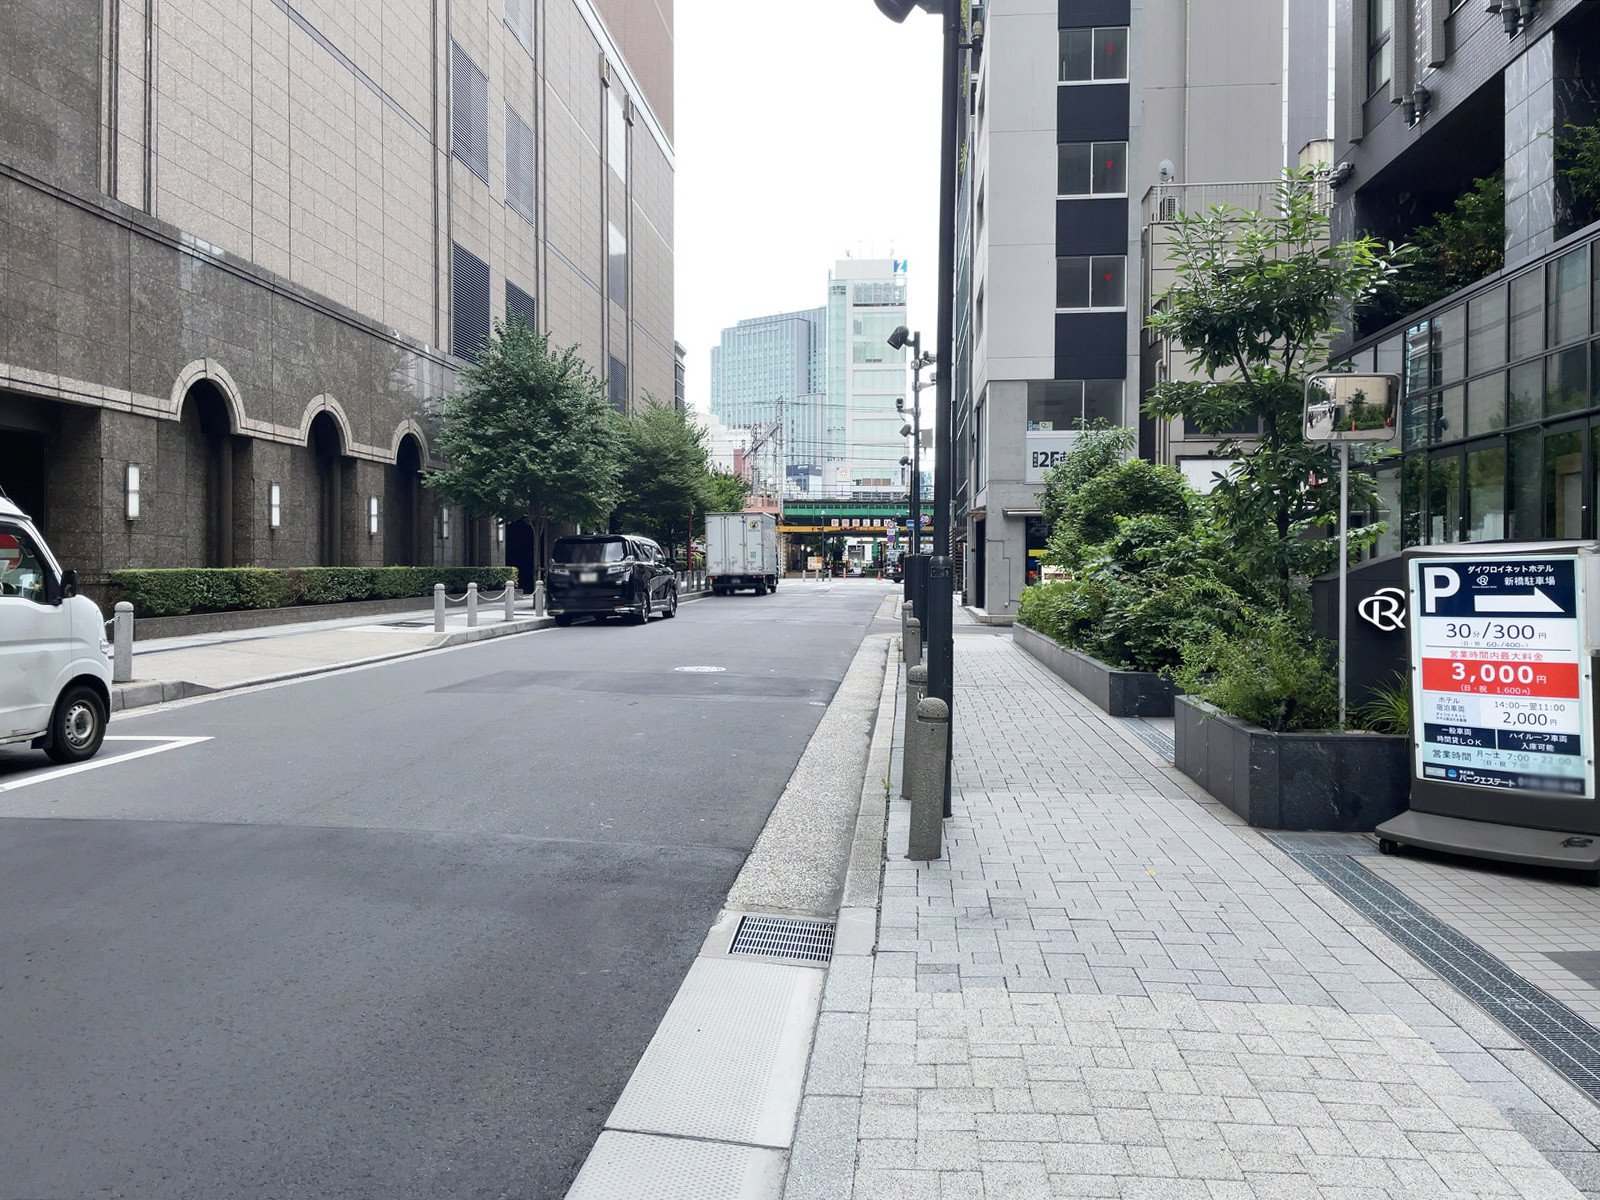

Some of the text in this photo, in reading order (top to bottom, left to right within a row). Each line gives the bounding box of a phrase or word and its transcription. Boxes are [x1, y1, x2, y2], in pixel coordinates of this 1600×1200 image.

[1467, 565, 1554, 574] ダイワロイネットホテル
[1504, 576, 1556, 586] 新橋駐車場
[1424, 567, 1460, 613] P
[1449, 650, 1544, 661] 営業時間内最大料金
[1452, 662, 1547, 684] 3,000円
[1438, 696, 1460, 704] ホテル
[1436, 703, 1465, 713] 宿泊車両
[1503, 711, 1558, 727] 2,000円
[1441, 727, 1472, 736] 一般車両
[1436, 735, 1482, 746] 時間貸しOK
[1509, 732, 1568, 744] ハイルーフ車両
[1521, 743, 1555, 752] 入庫可能
[1432, 749, 1472, 762] 営業時間
[1459, 774, 1516, 787] パークエステート
